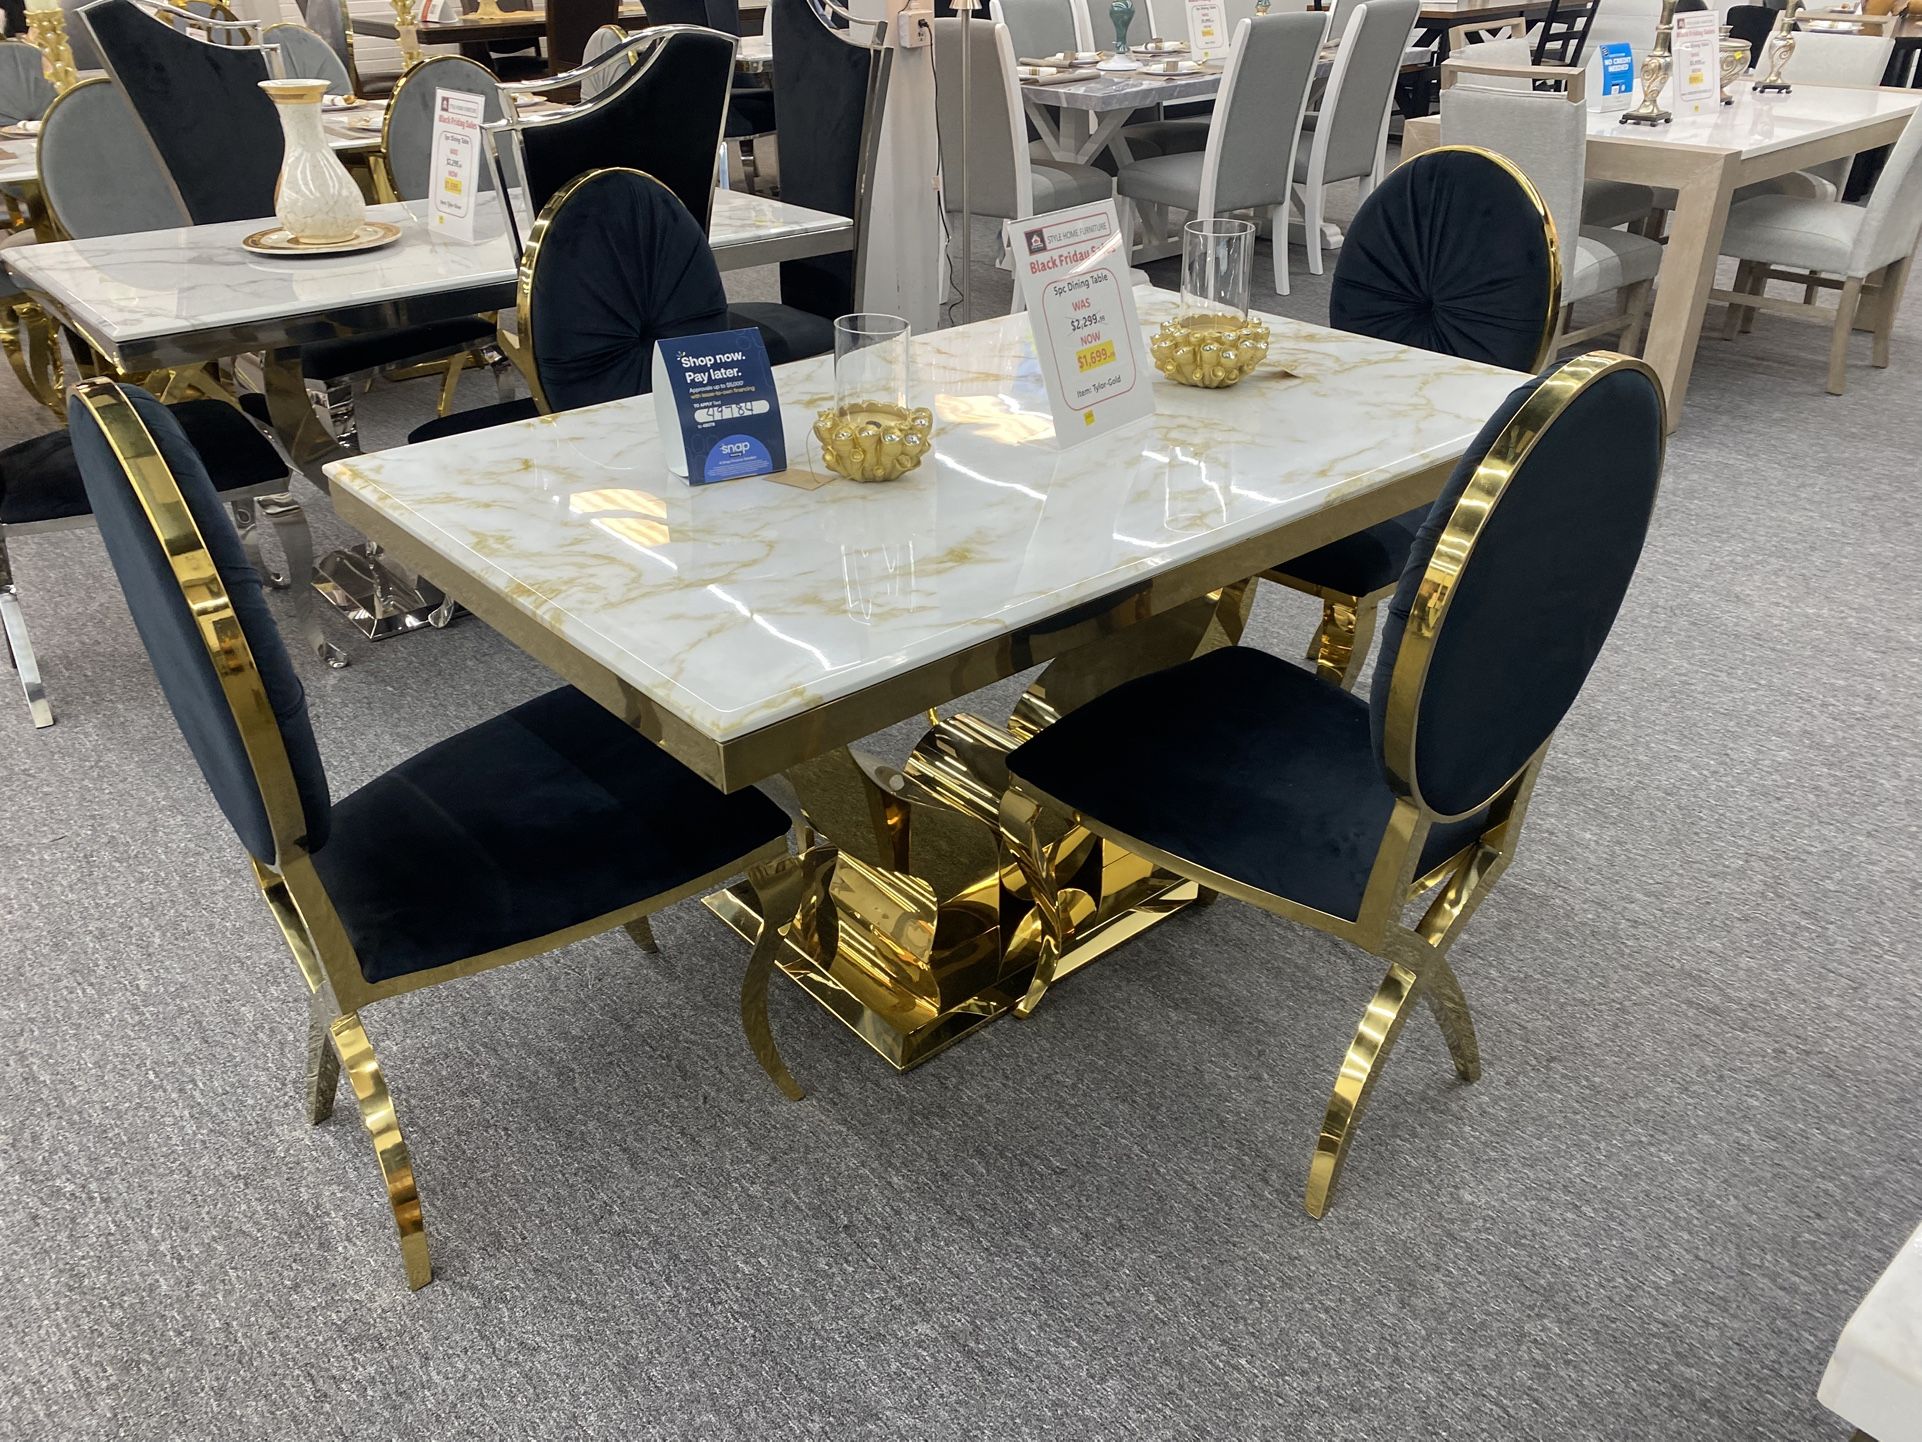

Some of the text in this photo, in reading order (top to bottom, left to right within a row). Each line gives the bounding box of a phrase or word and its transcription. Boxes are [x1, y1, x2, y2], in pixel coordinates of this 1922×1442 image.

[1047, 222, 1107, 244] STYLE HOME FURNITURE
[1029, 256, 1059, 275] Black
[1053, 271, 1109, 298] 5pc Dining Table
[1072, 297, 1091, 312] WAS
[1080, 330, 1101, 347] NOW
[681, 351, 746, 368] Shop now.
[685, 367, 742, 384] Pay later.
[689, 385, 713, 394] Approvals
[733, 386, 756, 394] financing
[1076, 387, 1093, 399] Item:
[721, 441, 750, 454] snap
